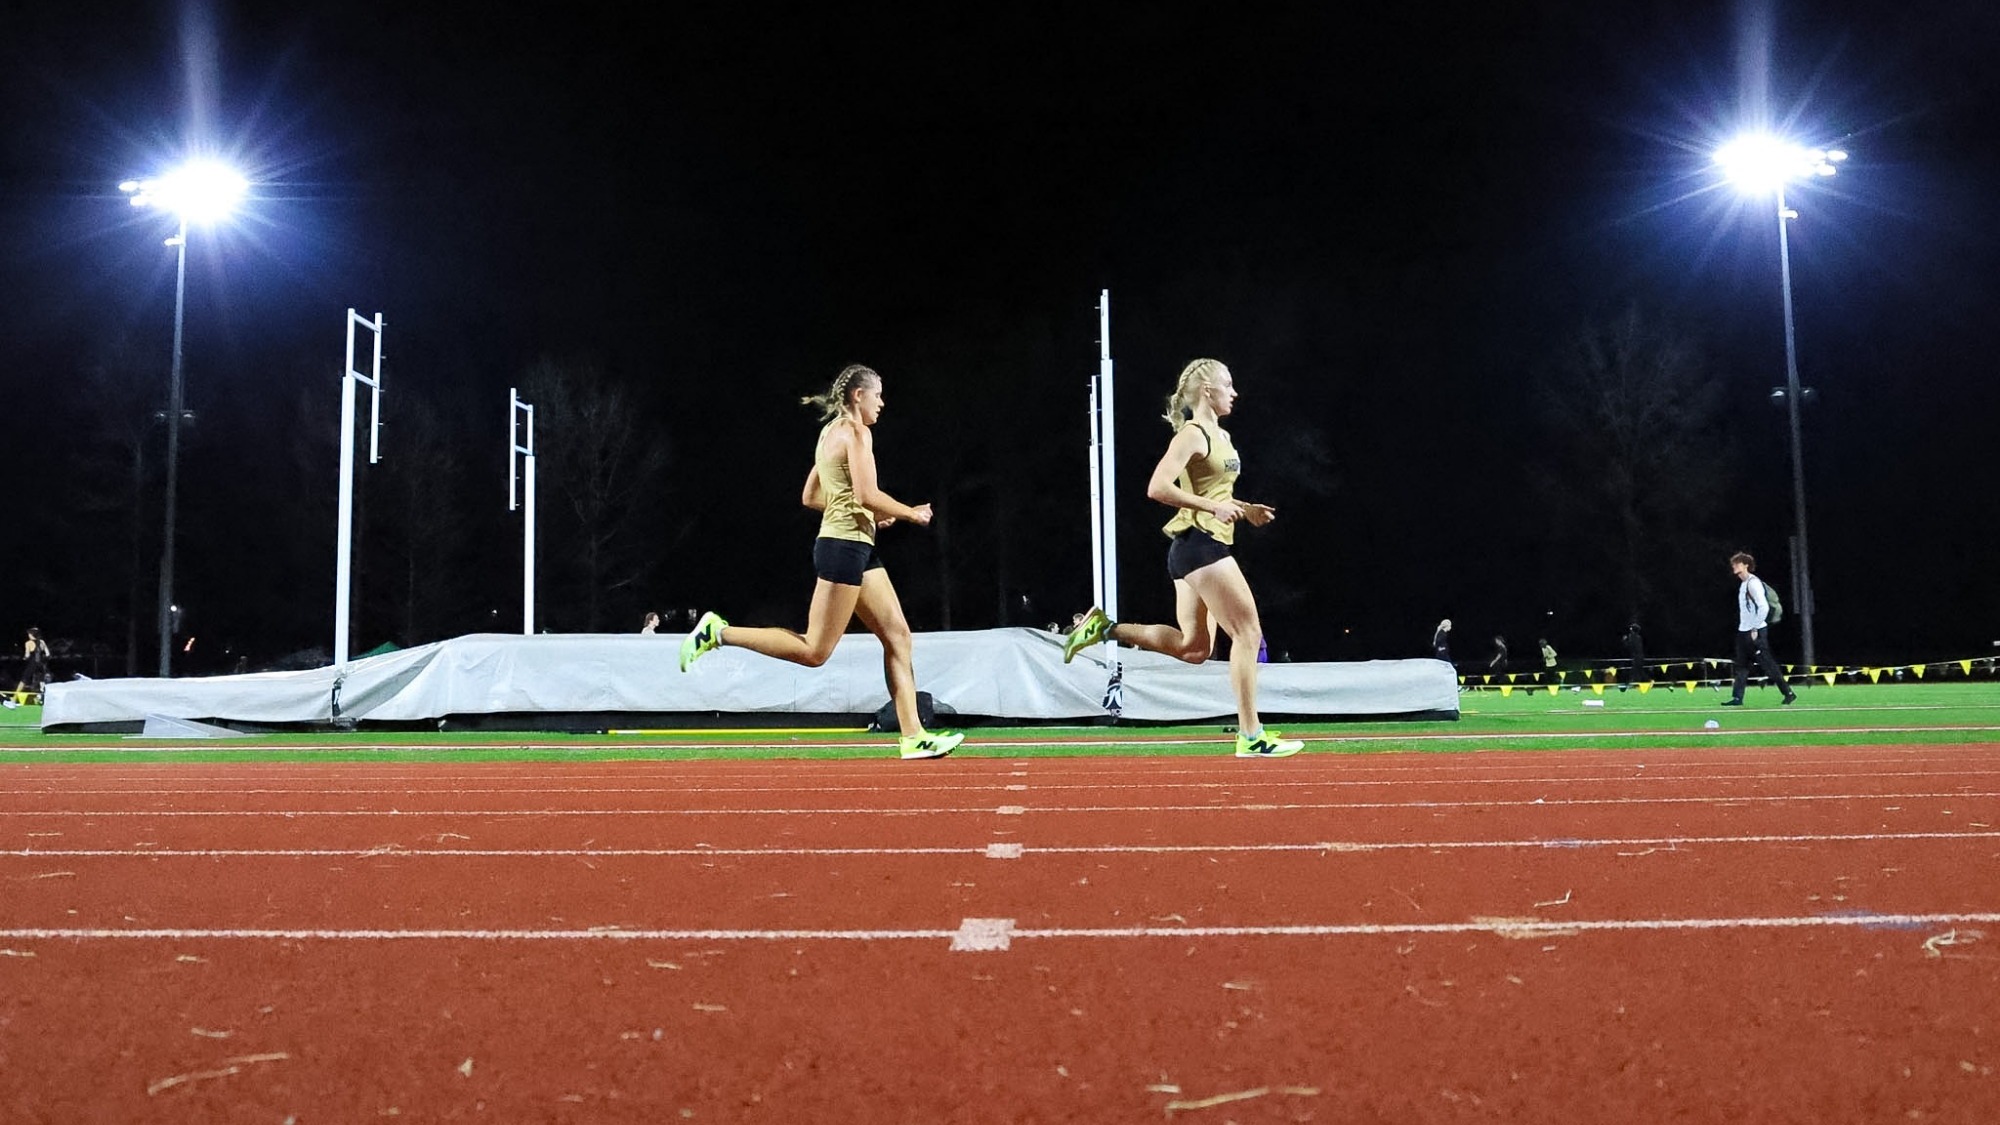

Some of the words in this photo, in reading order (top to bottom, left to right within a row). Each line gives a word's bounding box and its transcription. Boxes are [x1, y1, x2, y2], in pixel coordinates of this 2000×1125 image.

[695, 623, 712, 651] N
[915, 740, 934, 750] N
[1248, 739, 1278, 754] N
